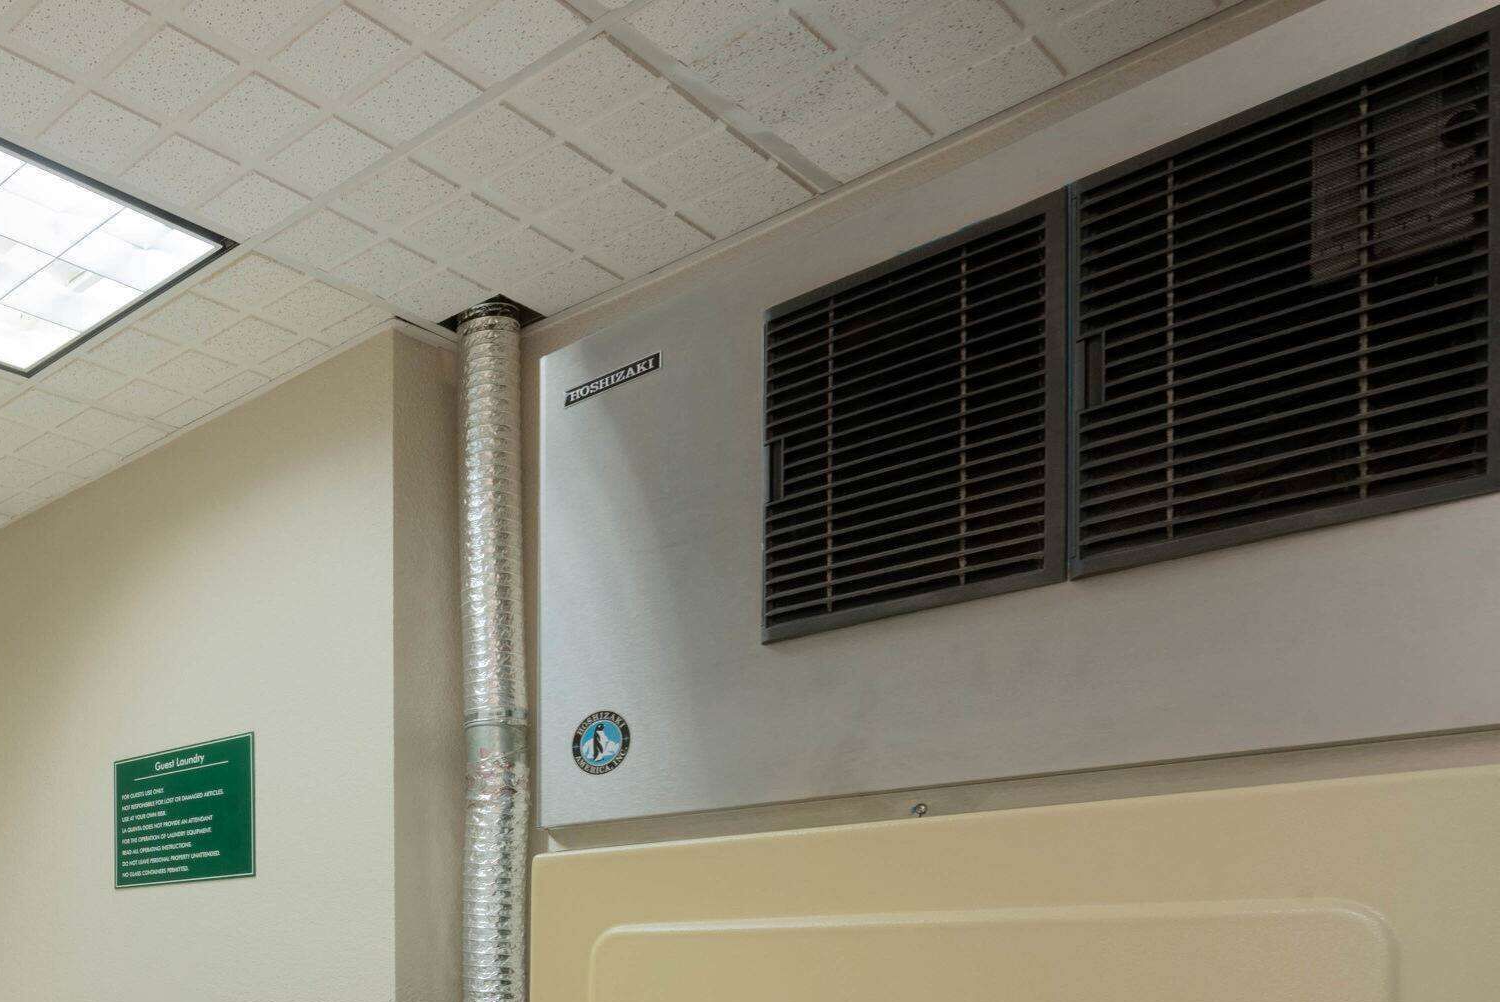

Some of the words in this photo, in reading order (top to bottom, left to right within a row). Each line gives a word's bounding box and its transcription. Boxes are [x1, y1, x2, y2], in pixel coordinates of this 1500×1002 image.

[570, 358, 654, 401] HOSHIZAKI
[576, 711, 625, 735] HOSHIZAKI
[154, 759, 175, 771] Guest
[176, 753, 205, 767] Laundry
[131, 801, 155, 810] RESPONSIBLE
[181, 792, 203, 801] DAMAGED
[163, 819, 180, 828] PROVIDE
[188, 814, 213, 824] ATTENDANT
[138, 834, 160, 843] OPERATION
[167, 830, 186, 839] LAUNDRY
[139, 845, 161, 854] OPERATING
[149, 855, 170, 864] PERSONAL
[170, 852, 191, 861] PROPERTY
